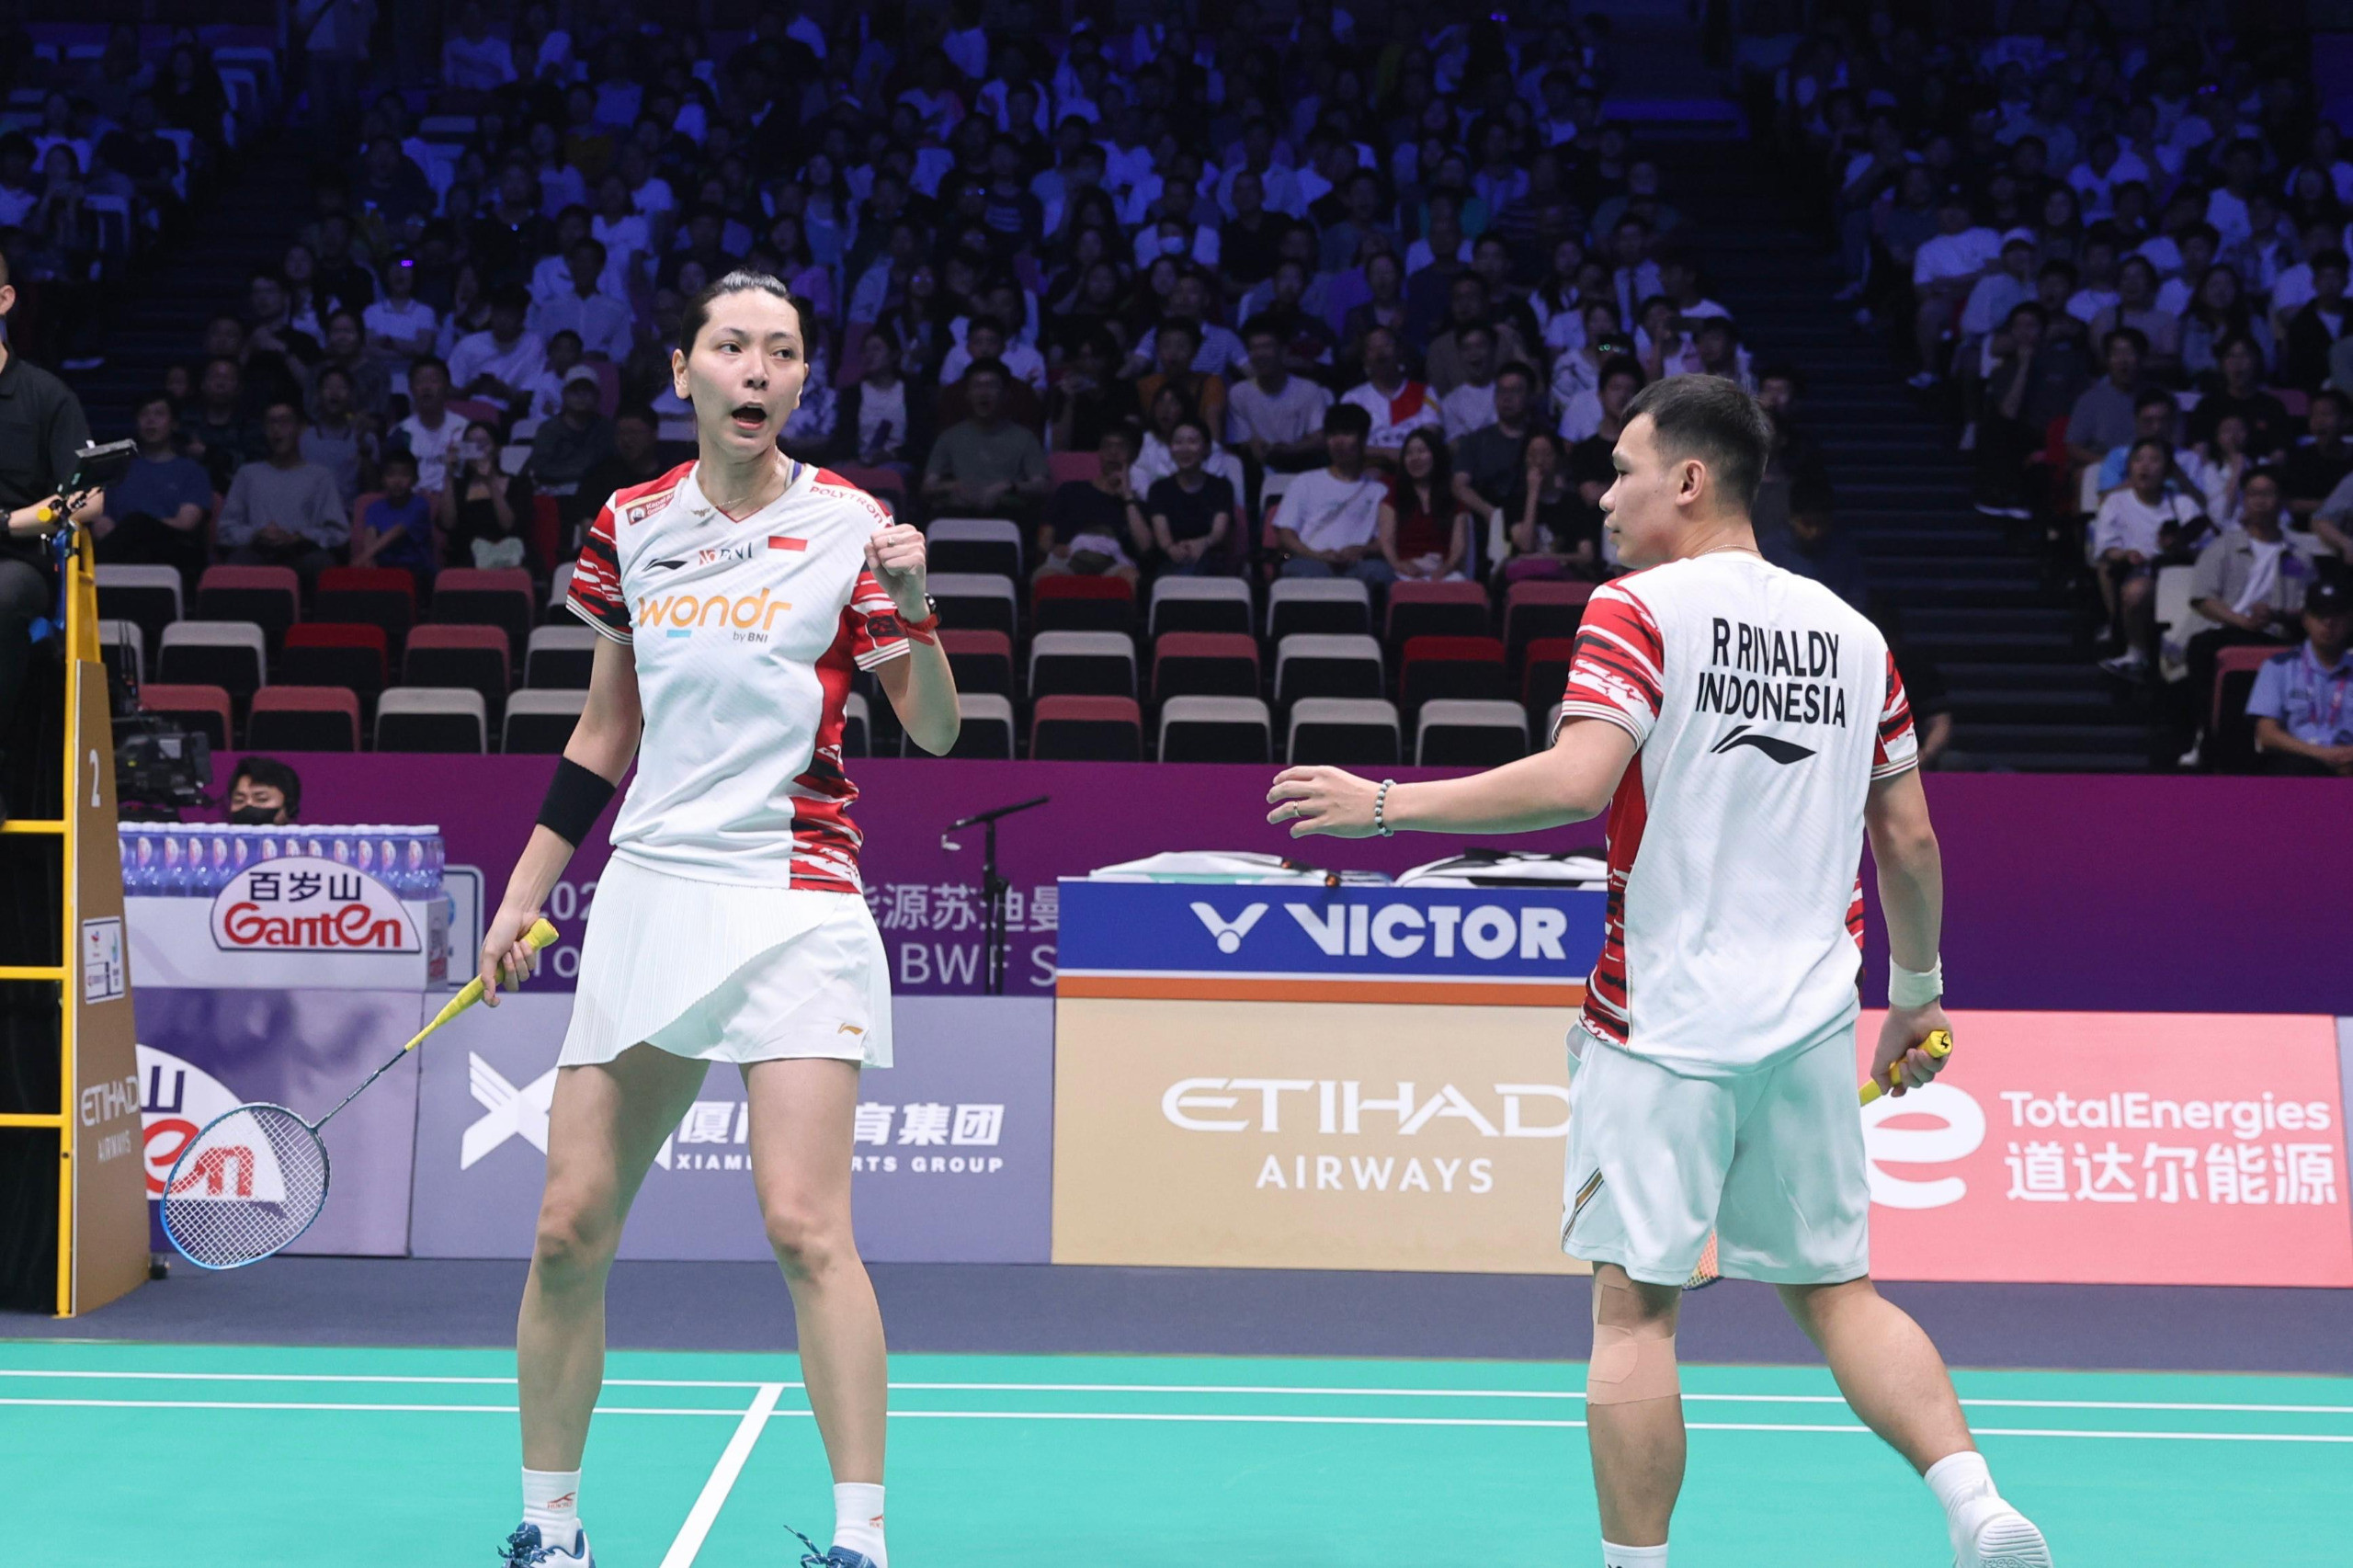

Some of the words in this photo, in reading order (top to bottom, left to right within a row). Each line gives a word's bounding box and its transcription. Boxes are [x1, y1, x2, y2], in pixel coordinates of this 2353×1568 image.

[638, 587, 792, 631] wondr
[733, 631, 746, 642] by
[747, 631, 768, 643] BNI
[1712, 617, 1731, 666] R
[1736, 621, 1839, 679] RIVALDY
[1695, 672, 1846, 728] INDONESIA
[89, 748, 100, 807] 2
[248, 871, 361, 903] 百岁山
[1284, 903, 1567, 960] VICTOR
[81, 1074, 138, 1127] ETIHAD
[1162, 1077, 1571, 1137] ETIHAD
[1999, 1091, 2331, 1141] TotalEnergies
[676, 1153, 753, 1171] XIAM
[910, 1155, 1005, 1174] GROUP
[1255, 1153, 1494, 1194] AIRWAYS
[2004, 1141, 2338, 1206] 道达尔能源
